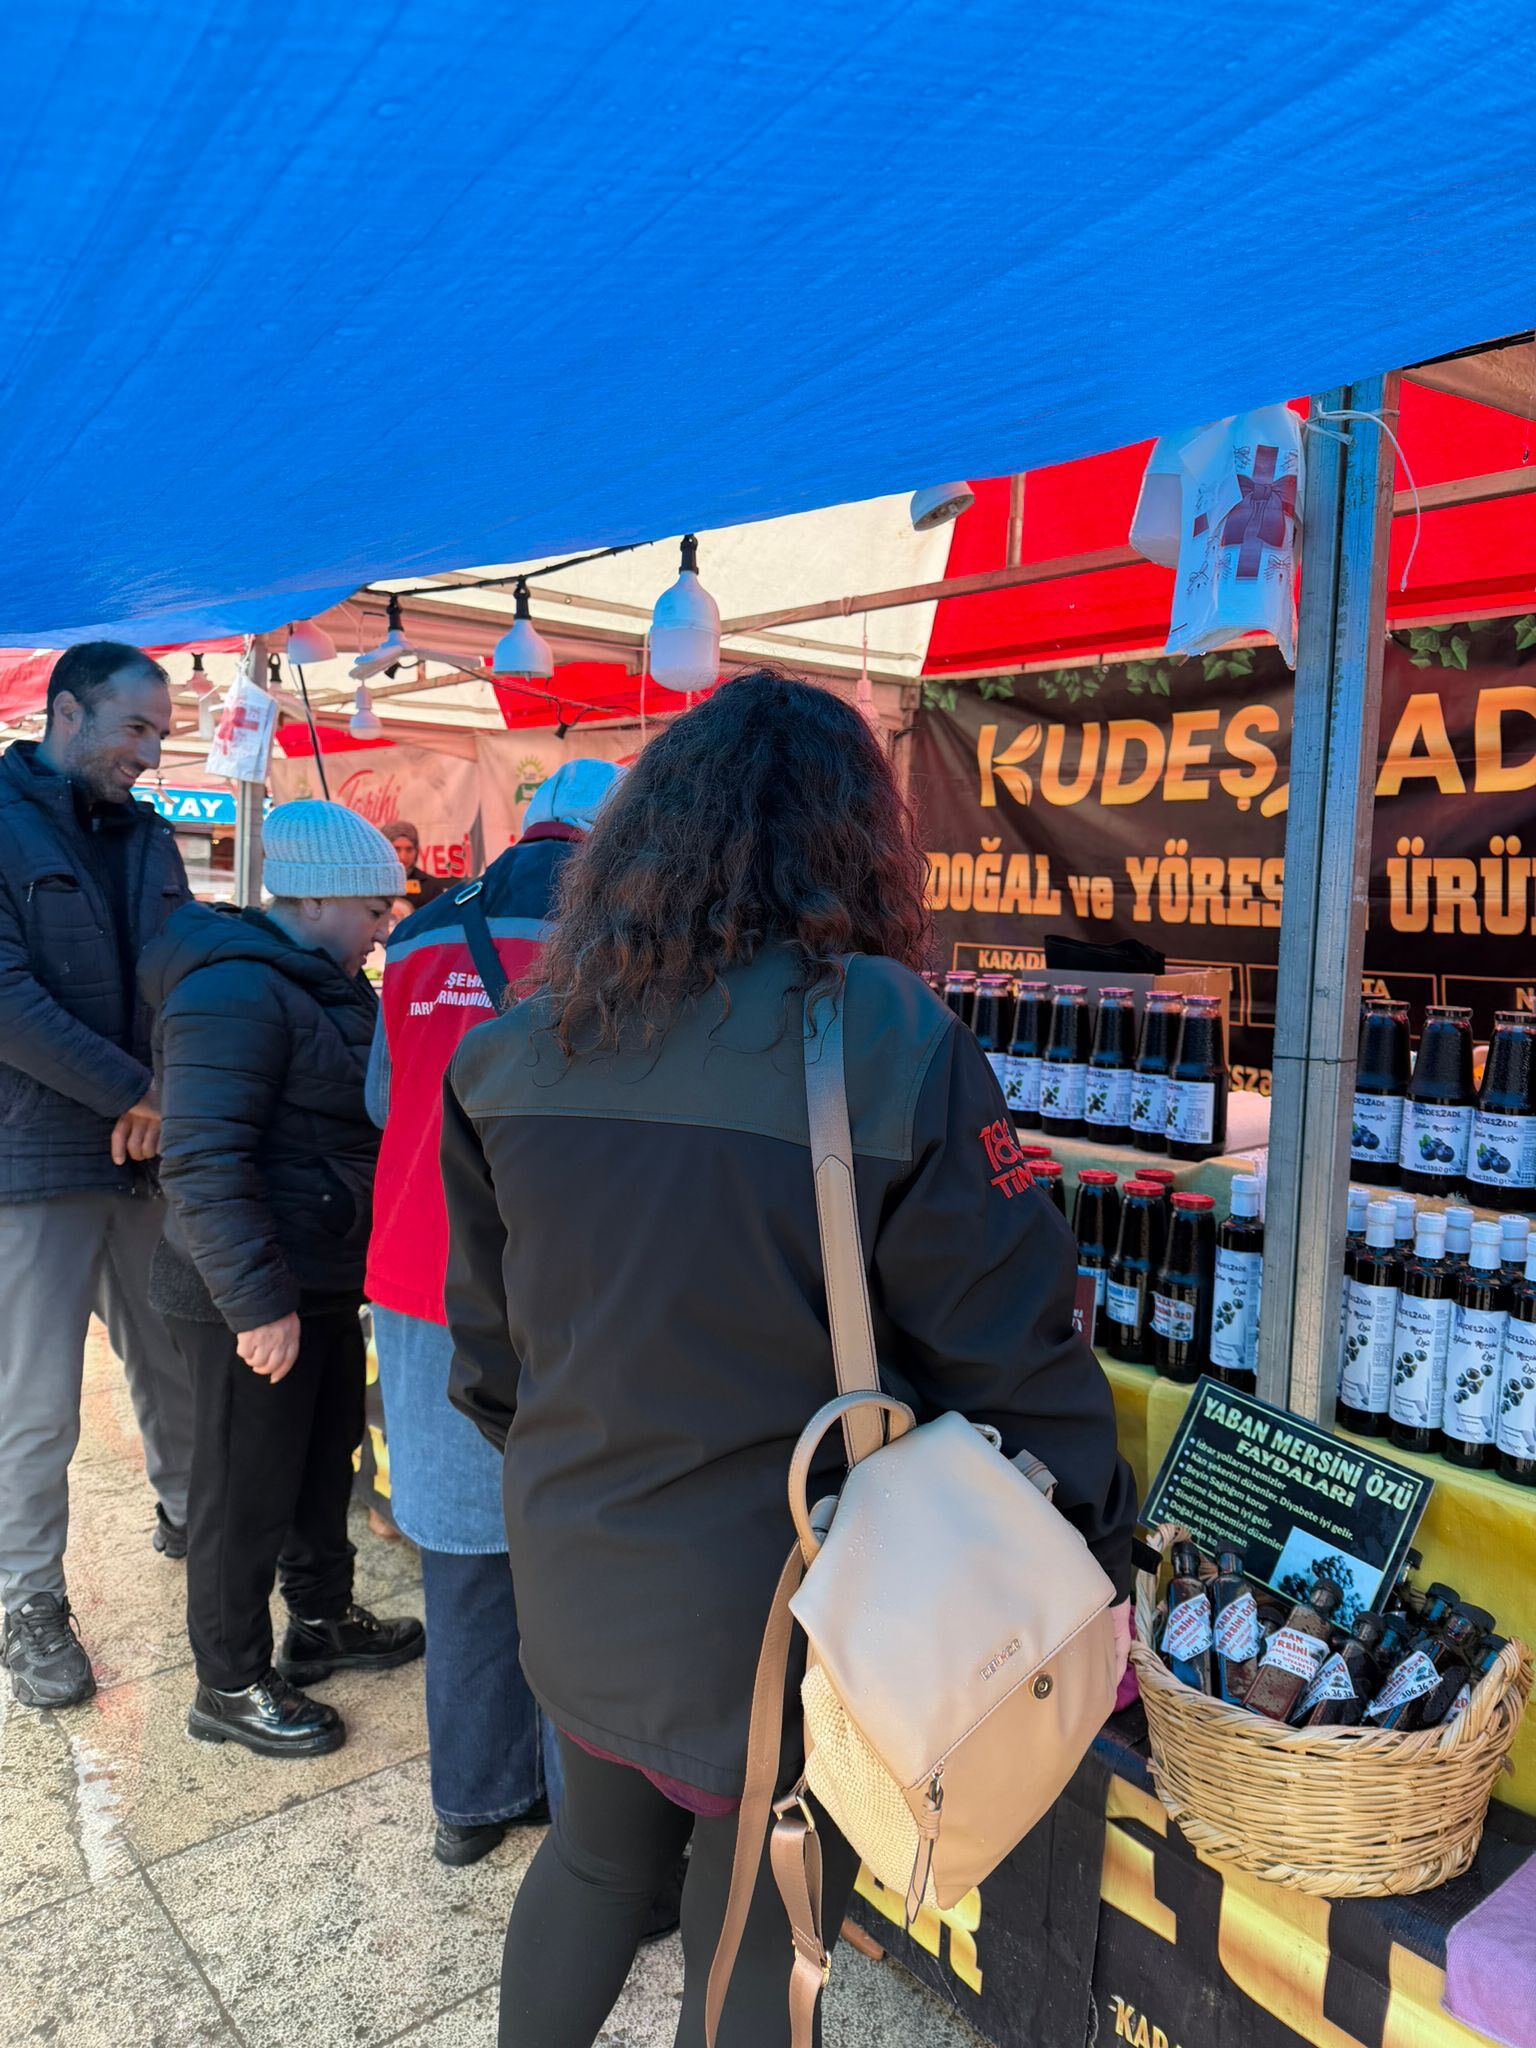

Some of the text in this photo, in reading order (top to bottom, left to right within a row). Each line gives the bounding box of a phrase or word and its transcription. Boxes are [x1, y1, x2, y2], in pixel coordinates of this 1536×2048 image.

[977, 685, 1536, 818] KUDEŞAD
[418, 833, 472, 878] YESİ
[924, 835, 1536, 936] DOĞAL ve YÖRES ÜRÜ
[978, 949, 1047, 971] KARAD
[1203, 1396, 1414, 1511] YABAN MERSİNİ ÖZÜ
[1236, 1439, 1356, 1508] FAYDALARI
[1174, 1488, 1209, 1511] Sindirim
[1180, 1476, 1208, 1496] Görme
[1185, 1463, 1210, 1481] Beyin
[1245, 1490, 1269, 1512] korur
[1190, 1451, 1208, 1466] Kan
[1279, 1496, 1319, 1523] Diyabete
[1251, 1467, 1287, 1491] temizler
[1169, 1500, 1193, 1519] Doğal
